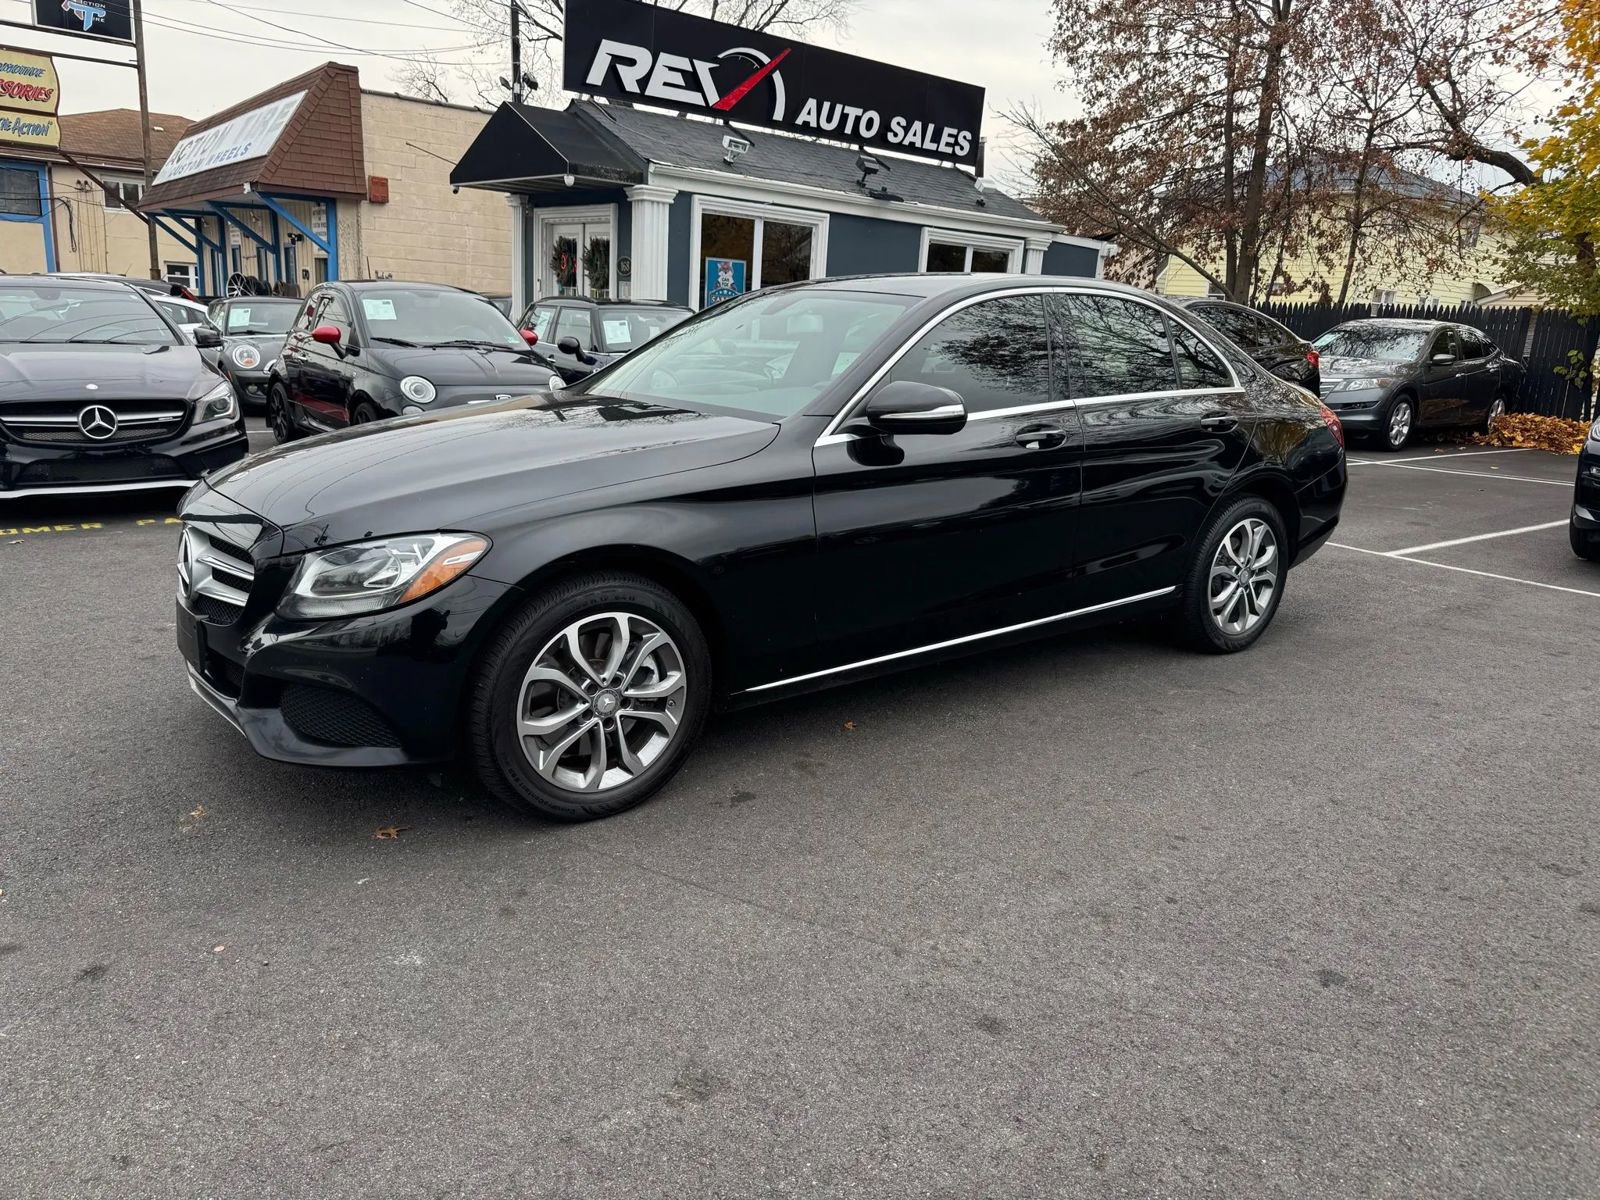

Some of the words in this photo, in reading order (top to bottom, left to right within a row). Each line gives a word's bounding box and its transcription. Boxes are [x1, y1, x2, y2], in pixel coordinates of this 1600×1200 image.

[586, 38, 791, 111] REV
[205, 142, 252, 166] WHEELS
[795, 97, 880, 138] AUTO
[887, 116, 972, 156] SALES
